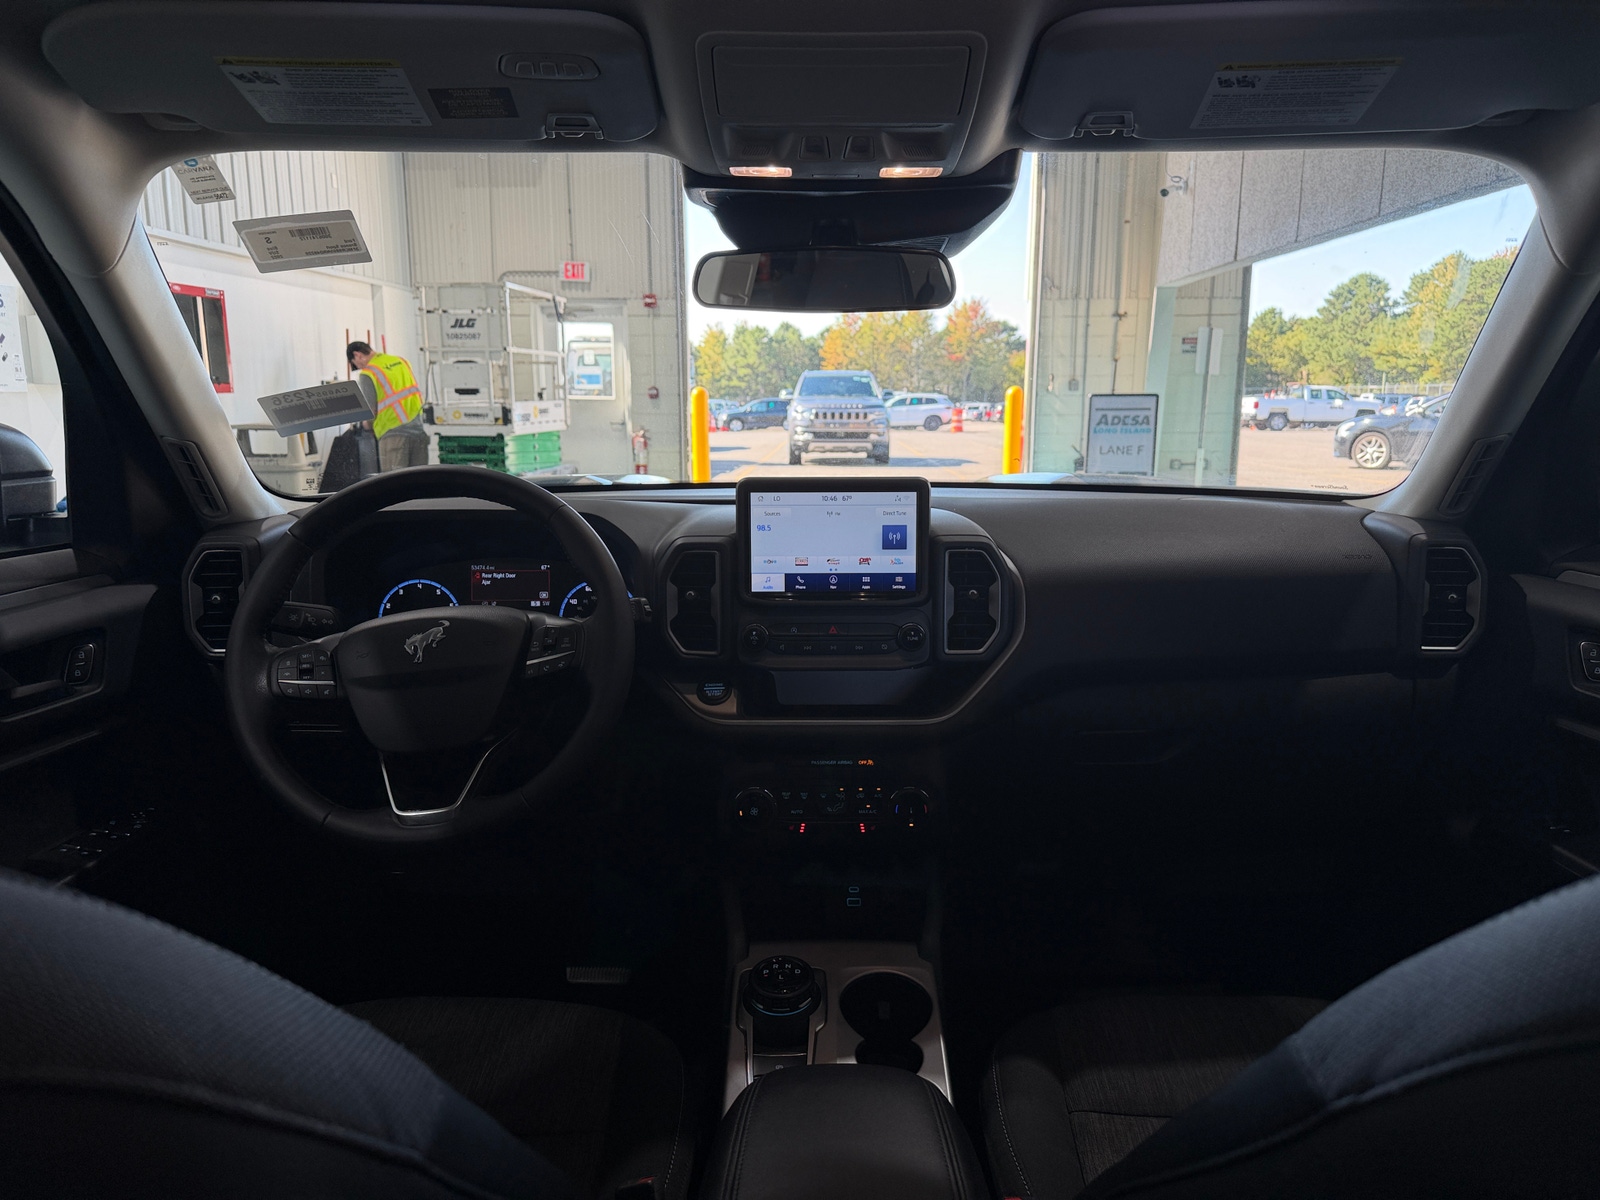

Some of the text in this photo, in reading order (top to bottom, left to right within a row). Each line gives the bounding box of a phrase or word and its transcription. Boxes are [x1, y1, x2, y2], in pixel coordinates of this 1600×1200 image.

[178, 166, 214, 174] CARVANA
[564, 262, 586, 280] EXIT
[450, 318, 477, 328] JLG
[1096, 414, 1150, 426] ADESA
[1099, 445, 1145, 455] LANE F
